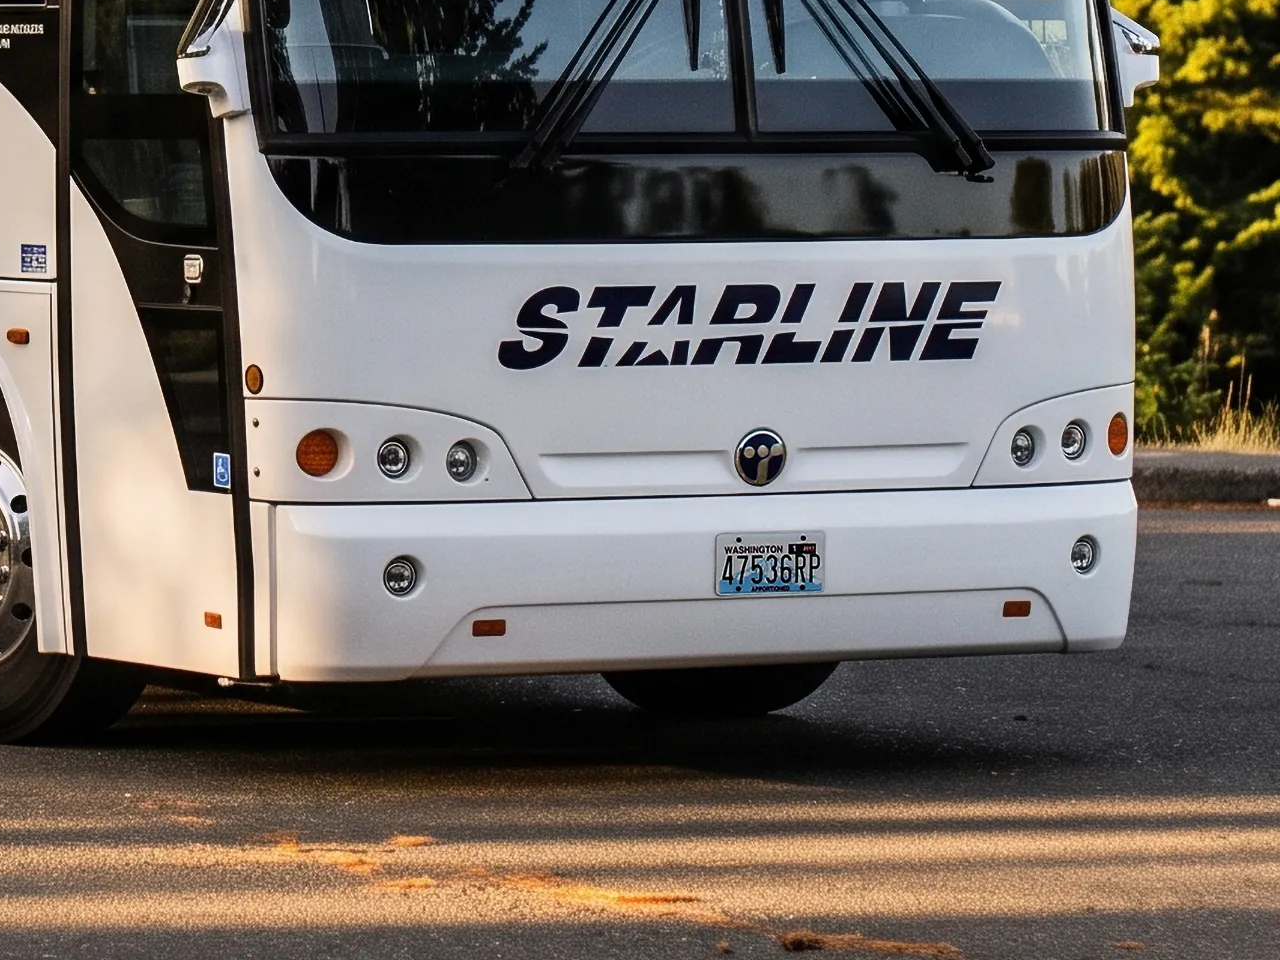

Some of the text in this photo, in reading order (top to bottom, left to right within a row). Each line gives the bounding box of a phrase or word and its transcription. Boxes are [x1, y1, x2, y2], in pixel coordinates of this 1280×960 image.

[497, 280, 1003, 371] STARLINE
[724, 544, 784, 555] WASHINGTON
[721, 553, 821, 586] 47536RP
